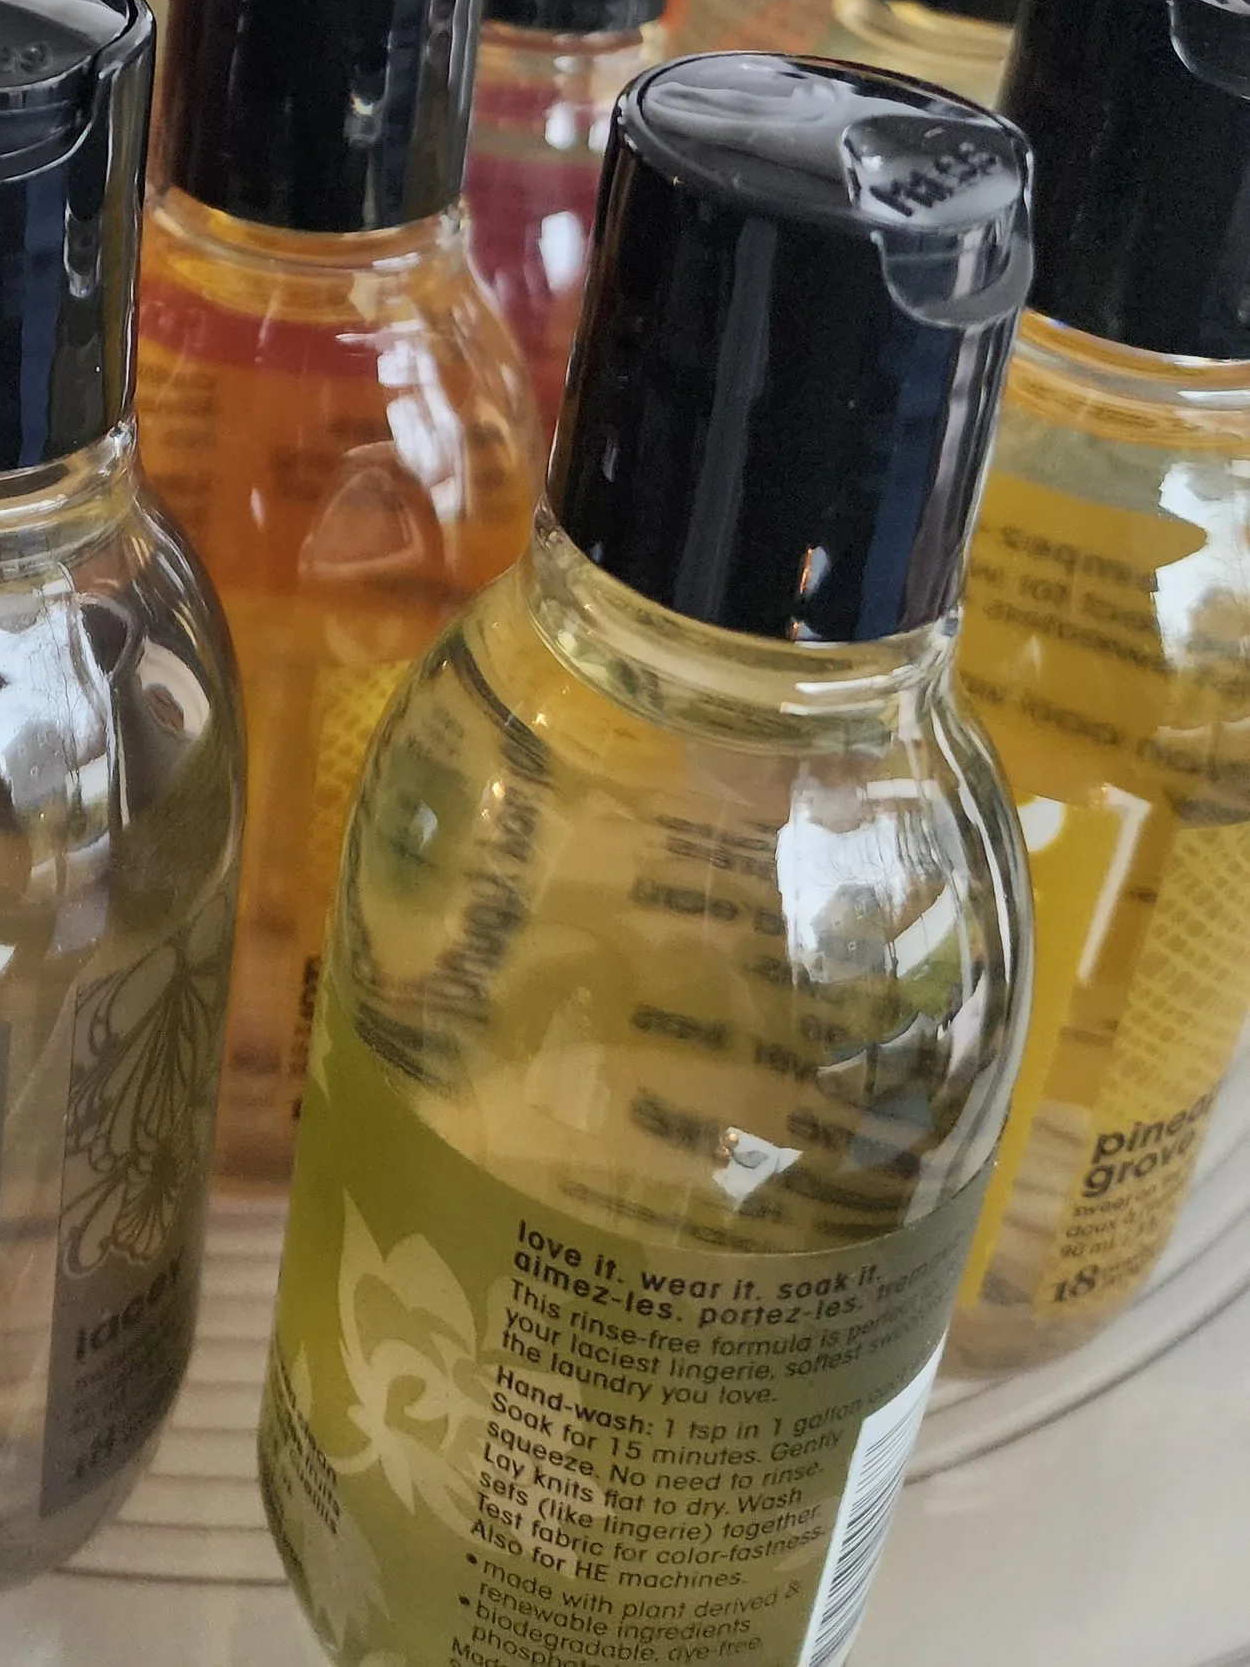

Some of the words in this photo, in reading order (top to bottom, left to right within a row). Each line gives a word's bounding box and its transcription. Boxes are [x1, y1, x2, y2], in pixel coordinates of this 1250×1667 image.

[514, 1250, 682, 1322] aimez-les.
[698, 1297, 863, 1328] portez-les.
[518, 1219, 581, 1267] love
[594, 1254, 625, 1284] it.
[641, 1271, 720, 1299] wear
[733, 1279, 761, 1301] it.
[776, 1272, 849, 1301] soak
[858, 1264, 881, 1286] it.
[506, 1307, 560, 1347] your
[570, 1333, 661, 1375] laciest
[669, 1357, 775, 1385] lingerie,
[511, 1278, 560, 1320] This
[570, 1310, 700, 1355] rinse-free
[712, 1334, 811, 1356] formula
[820, 1329, 839, 1350] is
[496, 1364, 652, 1435] Hand-wash:
[665, 1418, 675, 1439] 1
[688, 1421, 727, 1443] tsp
[736, 1421, 759, 1440] in
[773, 1417, 783, 1438] 1
[793, 1397, 864, 1435] gallon
[502, 1329, 542, 1364] the
[550, 1353, 653, 1402] laundry
[661, 1384, 708, 1406] you
[718, 1385, 778, 1406] love.
[487, 1419, 600, 1480] squeeze.
[609, 1463, 646, 1487] No
[656, 1473, 722, 1491] need
[730, 1475, 753, 1490] to
[762, 1460, 824, 1485] rinse.
[491, 1391, 553, 1436] Soak
[561, 1423, 598, 1451] for
[611, 1436, 643, 1461] 15
[652, 1446, 762, 1467] minutes.
[770, 1429, 841, 1462] Gently
[479, 1470, 529, 1508] sets
[538, 1497, 594, 1529] (like
[603, 1514, 713, 1545] lingerie)
[483, 1442, 526, 1479] Lay
[533, 1466, 594, 1504] knits
[603, 1489, 645, 1512] flat
[653, 1499, 678, 1517] to
[686, 1499, 730, 1520] dry.
[738, 1487, 803, 1515] Wash
[470, 1518, 524, 1556] Also
[531, 1547, 567, 1573] for
[574, 1561, 610, 1583] HE
[618, 1570, 750, 1589] machines.
[477, 1490, 524, 1531] Test
[531, 1520, 605, 1557] fabric
[613, 1542, 649, 1564] for
[478, 1581, 610, 1635] renewable
[617, 1619, 751, 1644] ingredients
[483, 1560, 554, 1601] made
[562, 1590, 613, 1615] with
[622, 1601, 687, 1622] plant
[694, 1589, 779, 1618] derived
[784, 1579, 801, 1599] &
[475, 1600, 660, 1663] biodegradable,
